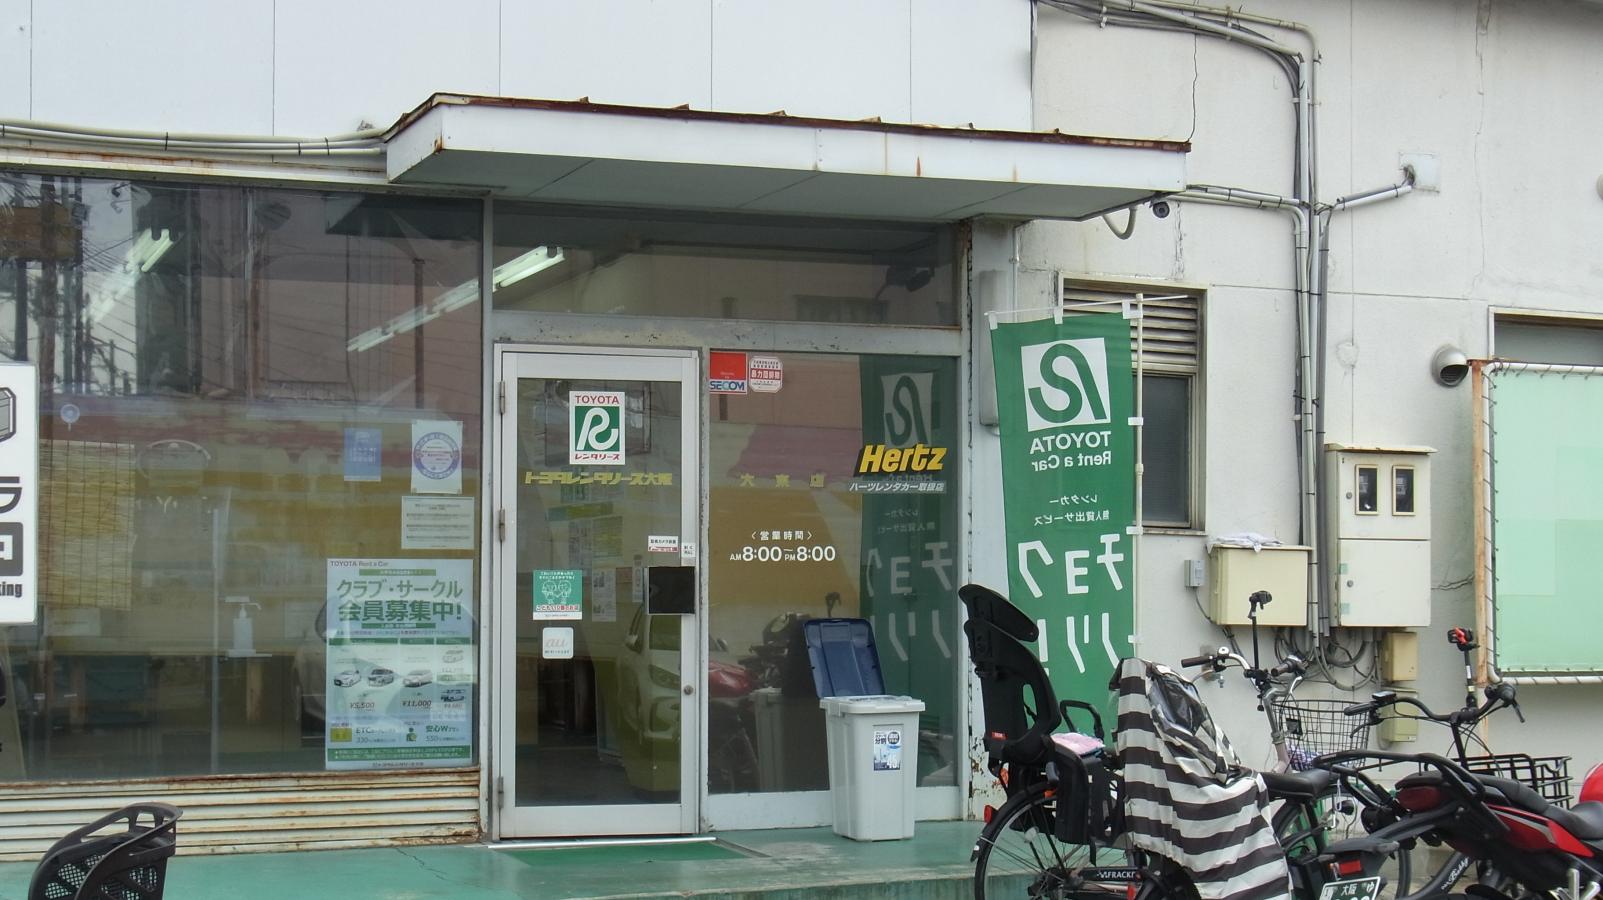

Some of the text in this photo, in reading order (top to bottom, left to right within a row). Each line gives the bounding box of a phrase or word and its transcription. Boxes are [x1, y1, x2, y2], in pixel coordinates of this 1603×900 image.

[709, 381, 745, 391] SECOM
[575, 395, 620, 404] TOYOTA
[575, 453, 620, 461] レンタリース
[858, 442, 948, 474] Hertz
[849, 482, 945, 493] ハーツレンタカー取扱店
[336, 578, 464, 598] クラブ・サークル
[338, 600, 462, 621] 会員募集中!
[402, 700, 432, 708] ¥11,000
[1341, 883, 1357, 897] 大阪
